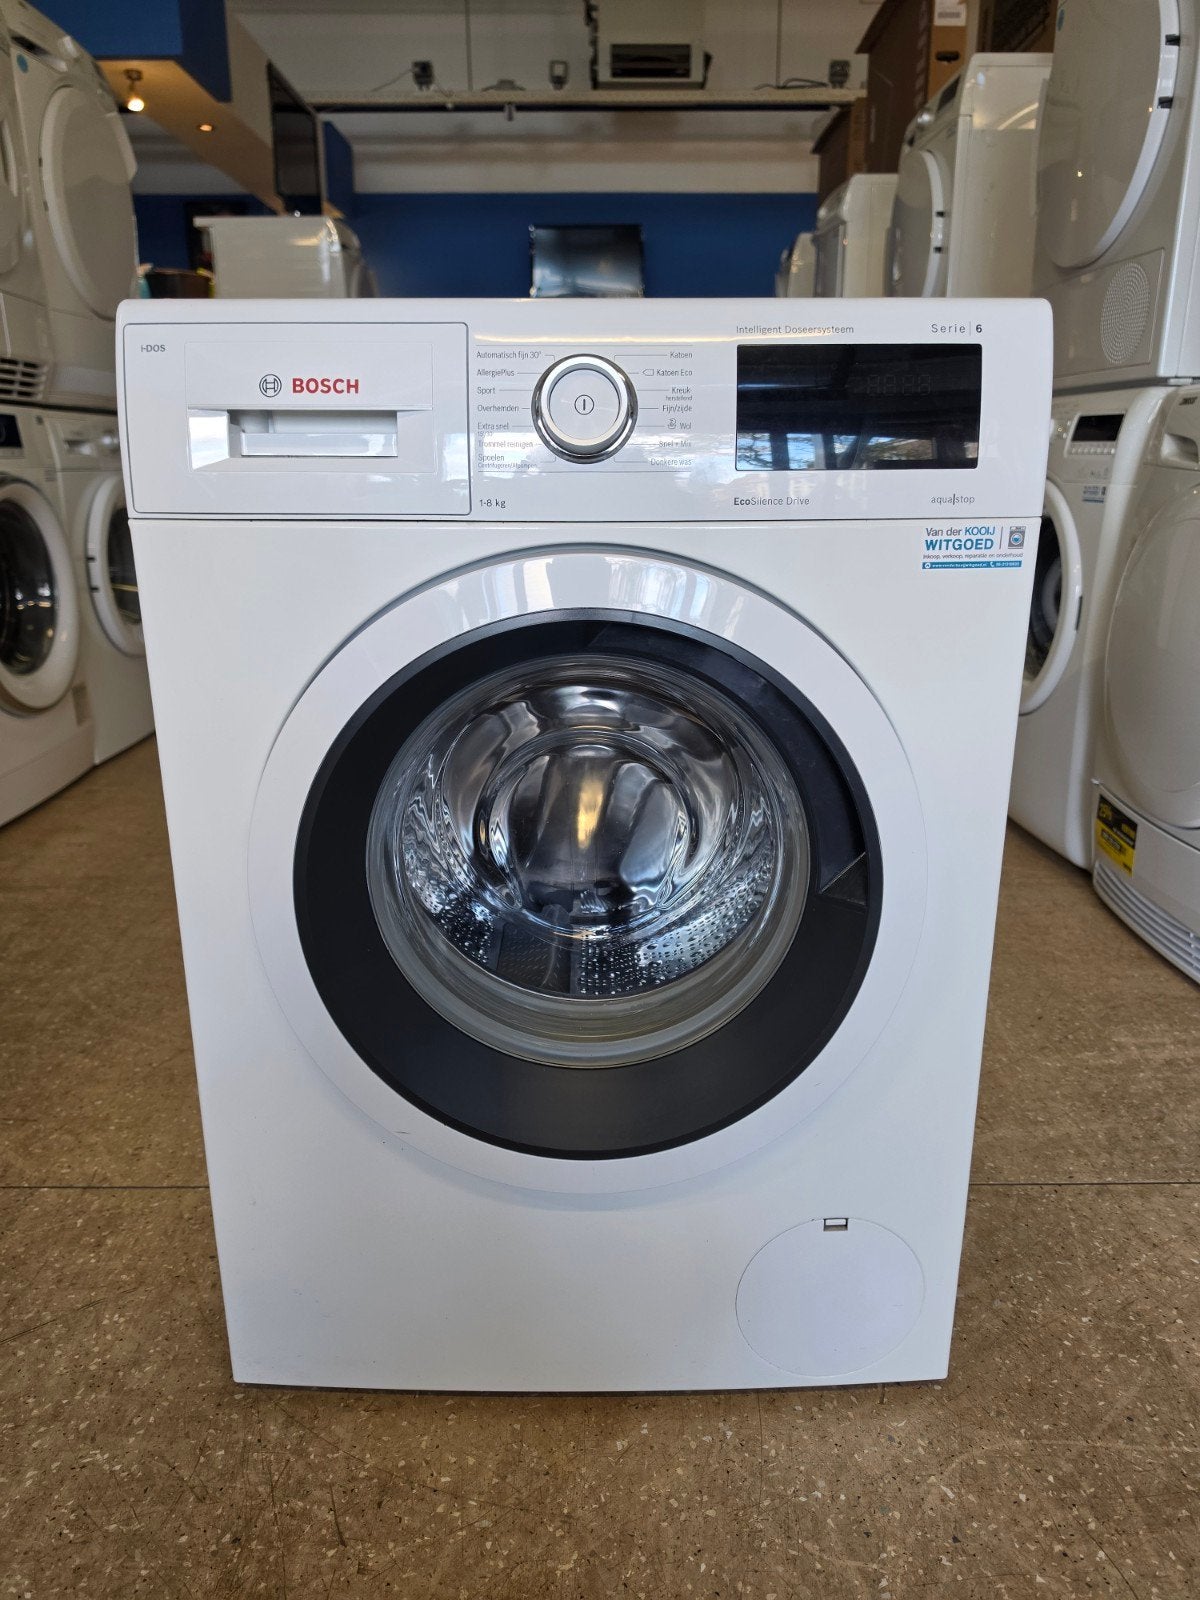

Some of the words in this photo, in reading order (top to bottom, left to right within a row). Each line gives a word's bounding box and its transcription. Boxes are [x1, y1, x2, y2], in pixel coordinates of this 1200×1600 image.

[736, 325, 783, 335] Intelligent
[784, 325, 855, 335] Doseersysteem
[930, 323, 966, 334] Serie
[975, 324, 983, 333] 6
[476, 350, 517, 359] Automatisch
[518, 350, 529, 360] fijn
[669, 351, 693, 359] Katoen
[476, 368, 515, 378] AllergiePlus
[656, 368, 679, 376] Katoen
[680, 368, 693, 376] Eco
[292, 377, 360, 394] BOSCH
[477, 386, 496, 395] Sport
[477, 404, 520, 412] Overhemden
[662, 404, 693, 413] Fijn/zijde
[477, 421, 495, 430] Extra
[496, 421, 509, 430] snel
[679, 422, 692, 430] Wol
[507, 440, 534, 450] reinigen
[478, 453, 505, 462] Spoelen
[479, 498, 493, 508] 1-8
[495, 498, 506, 509] kg
[733, 496, 784, 506] EcoSilence
[786, 496, 810, 506] Drive
[925, 527, 944, 537] Van
[945, 526, 962, 536] der
[964, 526, 996, 536] KOOIJ
[924, 538, 994, 551] WITGOED
